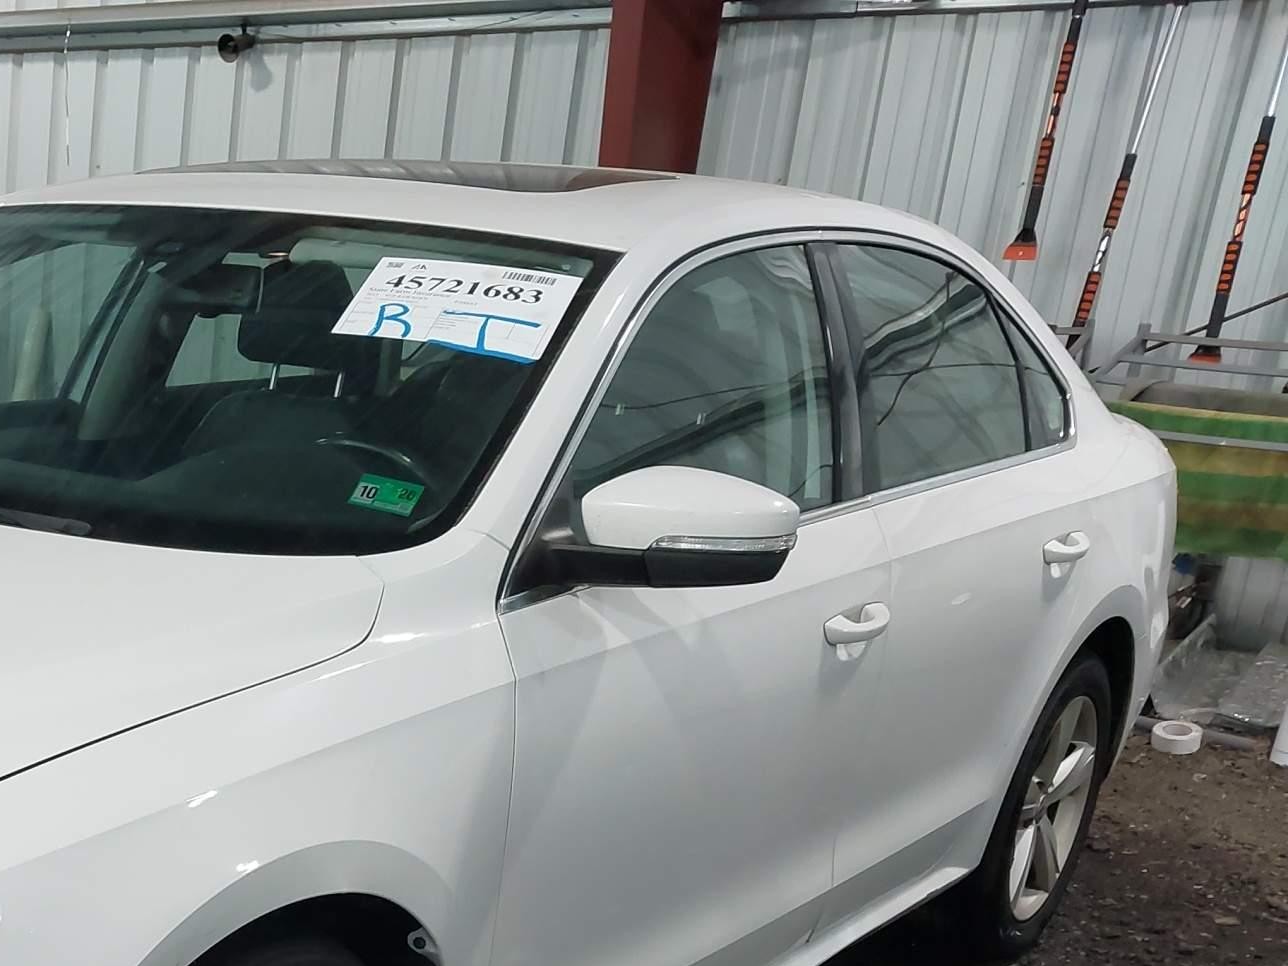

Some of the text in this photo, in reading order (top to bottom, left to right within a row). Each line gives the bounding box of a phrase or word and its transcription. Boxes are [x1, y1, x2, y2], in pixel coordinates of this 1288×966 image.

[386, 273, 544, 304] 45721683
[368, 302, 411, 338] R
[360, 485, 379, 499] 10
